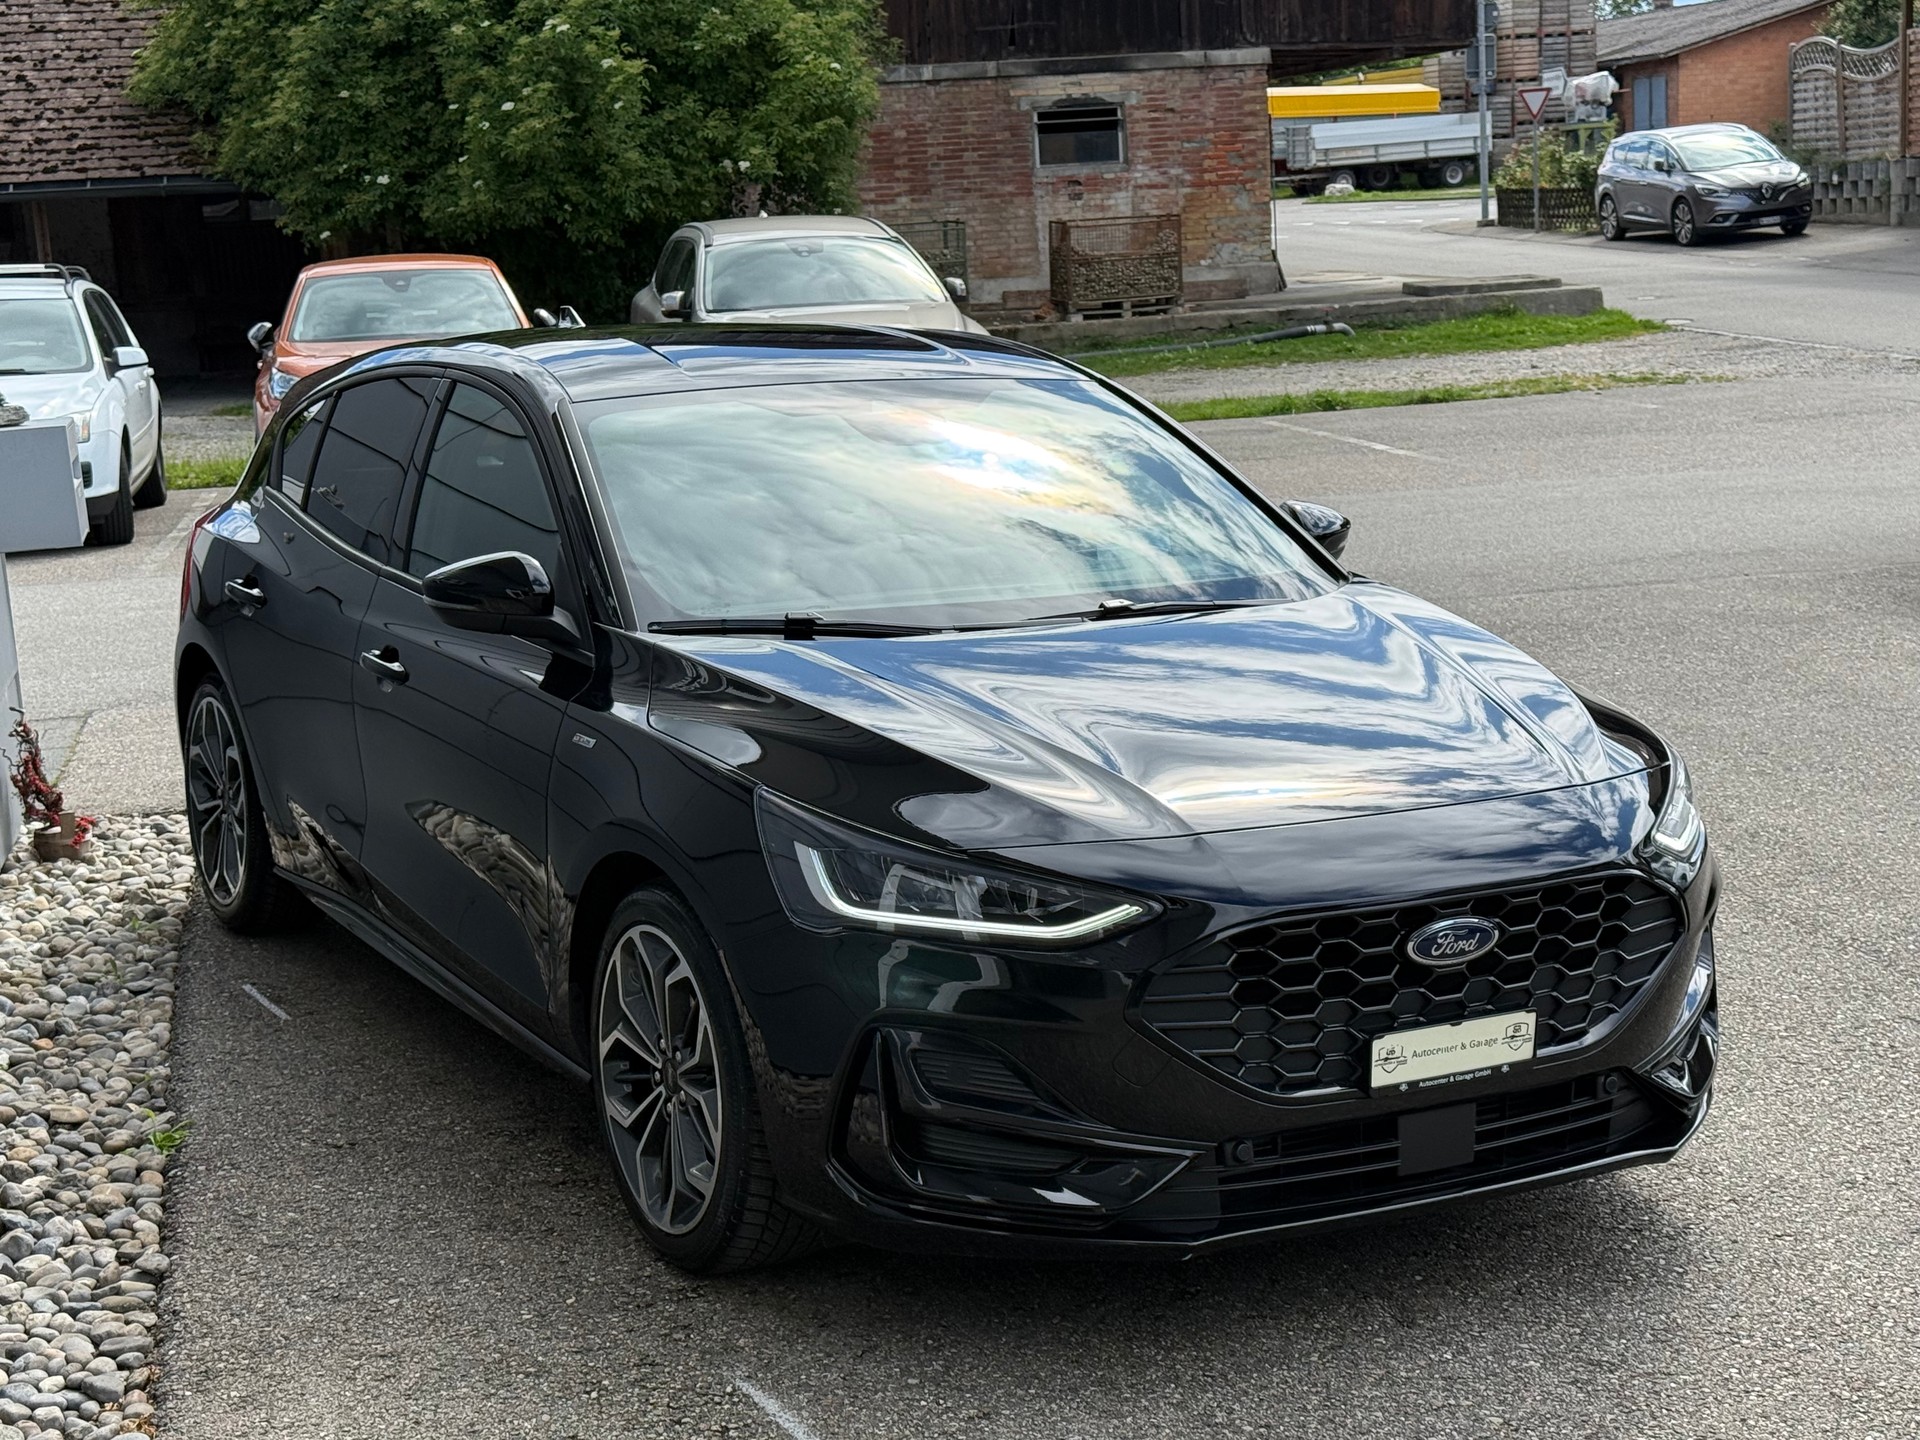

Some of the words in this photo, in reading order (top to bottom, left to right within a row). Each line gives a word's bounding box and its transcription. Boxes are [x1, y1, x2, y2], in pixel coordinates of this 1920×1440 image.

[1431, 929, 1480, 956] Ford
[1411, 1044, 1458, 1059] Autocenter
[1460, 1041, 1467, 1051] &
[1469, 1036, 1498, 1048] Garage
[1419, 1077, 1449, 1087] Autocenter
[1449, 1075, 1455, 1083] &
[1455, 1071, 1474, 1081] Garage
[1474, 1068, 1491, 1078] GmbH
